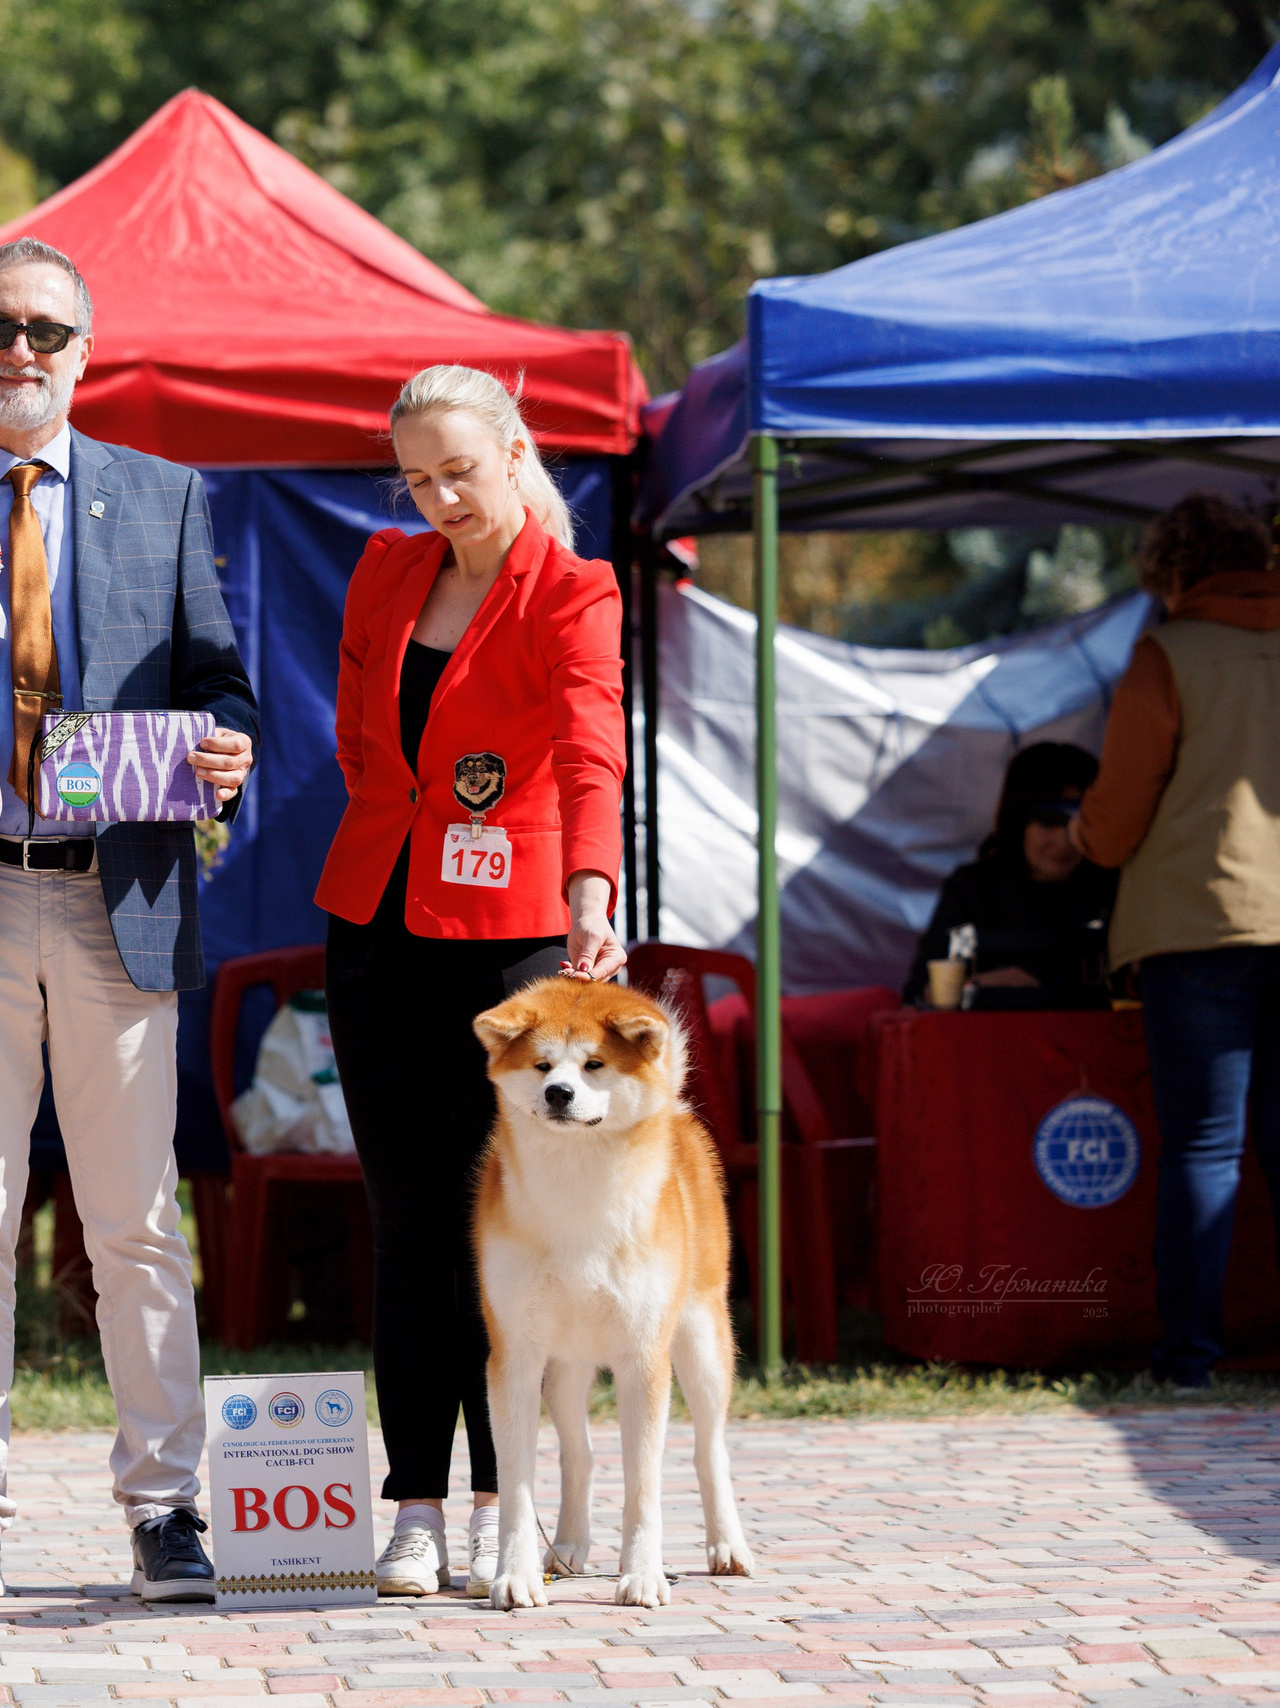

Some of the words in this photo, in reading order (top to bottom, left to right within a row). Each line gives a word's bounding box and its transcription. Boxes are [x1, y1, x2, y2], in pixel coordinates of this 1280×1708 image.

[66, 779, 92, 791] BOS
[451, 848, 506, 880] 179
[1068, 1140, 1109, 1163] FCI
[232, 1408, 246, 1416] FCI
[276, 1406, 296, 1415] FCI
[222, 1440, 267, 1448] CYNOLOGICAL
[268, 1438, 307, 1446] FEDERATION
[223, 1448, 302, 1459] INTERNATIONAL
[303, 1446, 324, 1456] DOG
[326, 1445, 355, 1455] SHOW
[265, 1458, 315, 1467] CACIB-FCI
[227, 1482, 357, 1533] BOS
[270, 1556, 322, 1566] TASHKENT
